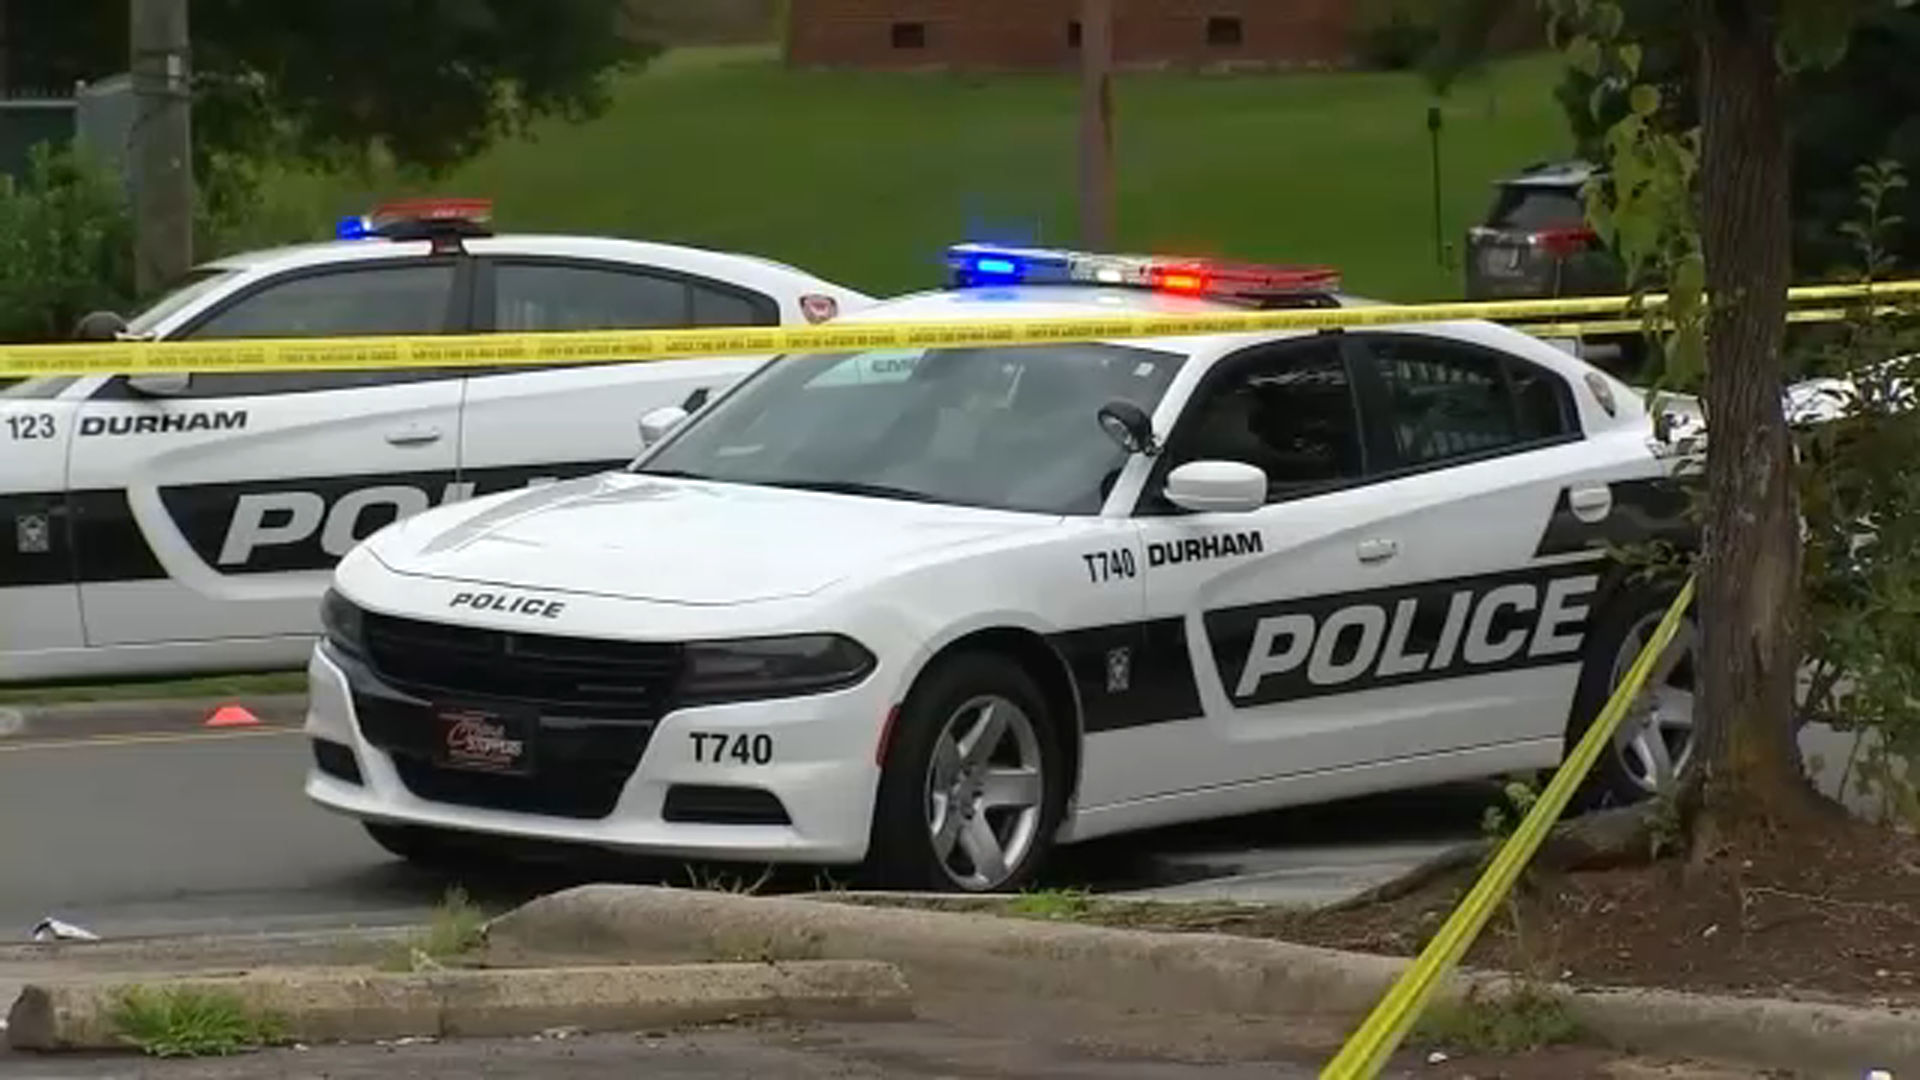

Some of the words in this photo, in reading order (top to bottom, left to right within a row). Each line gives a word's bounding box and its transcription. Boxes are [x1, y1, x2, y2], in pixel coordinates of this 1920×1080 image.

[7, 413, 56, 440] 123
[79, 410, 248, 437] DURHAM
[1082, 547, 1136, 583] T740
[1147, 529, 1264, 568] DURHAM
[449, 592, 566, 620] POLICE
[1233, 573, 1599, 699] POLICE
[688, 731, 774, 766] T740
